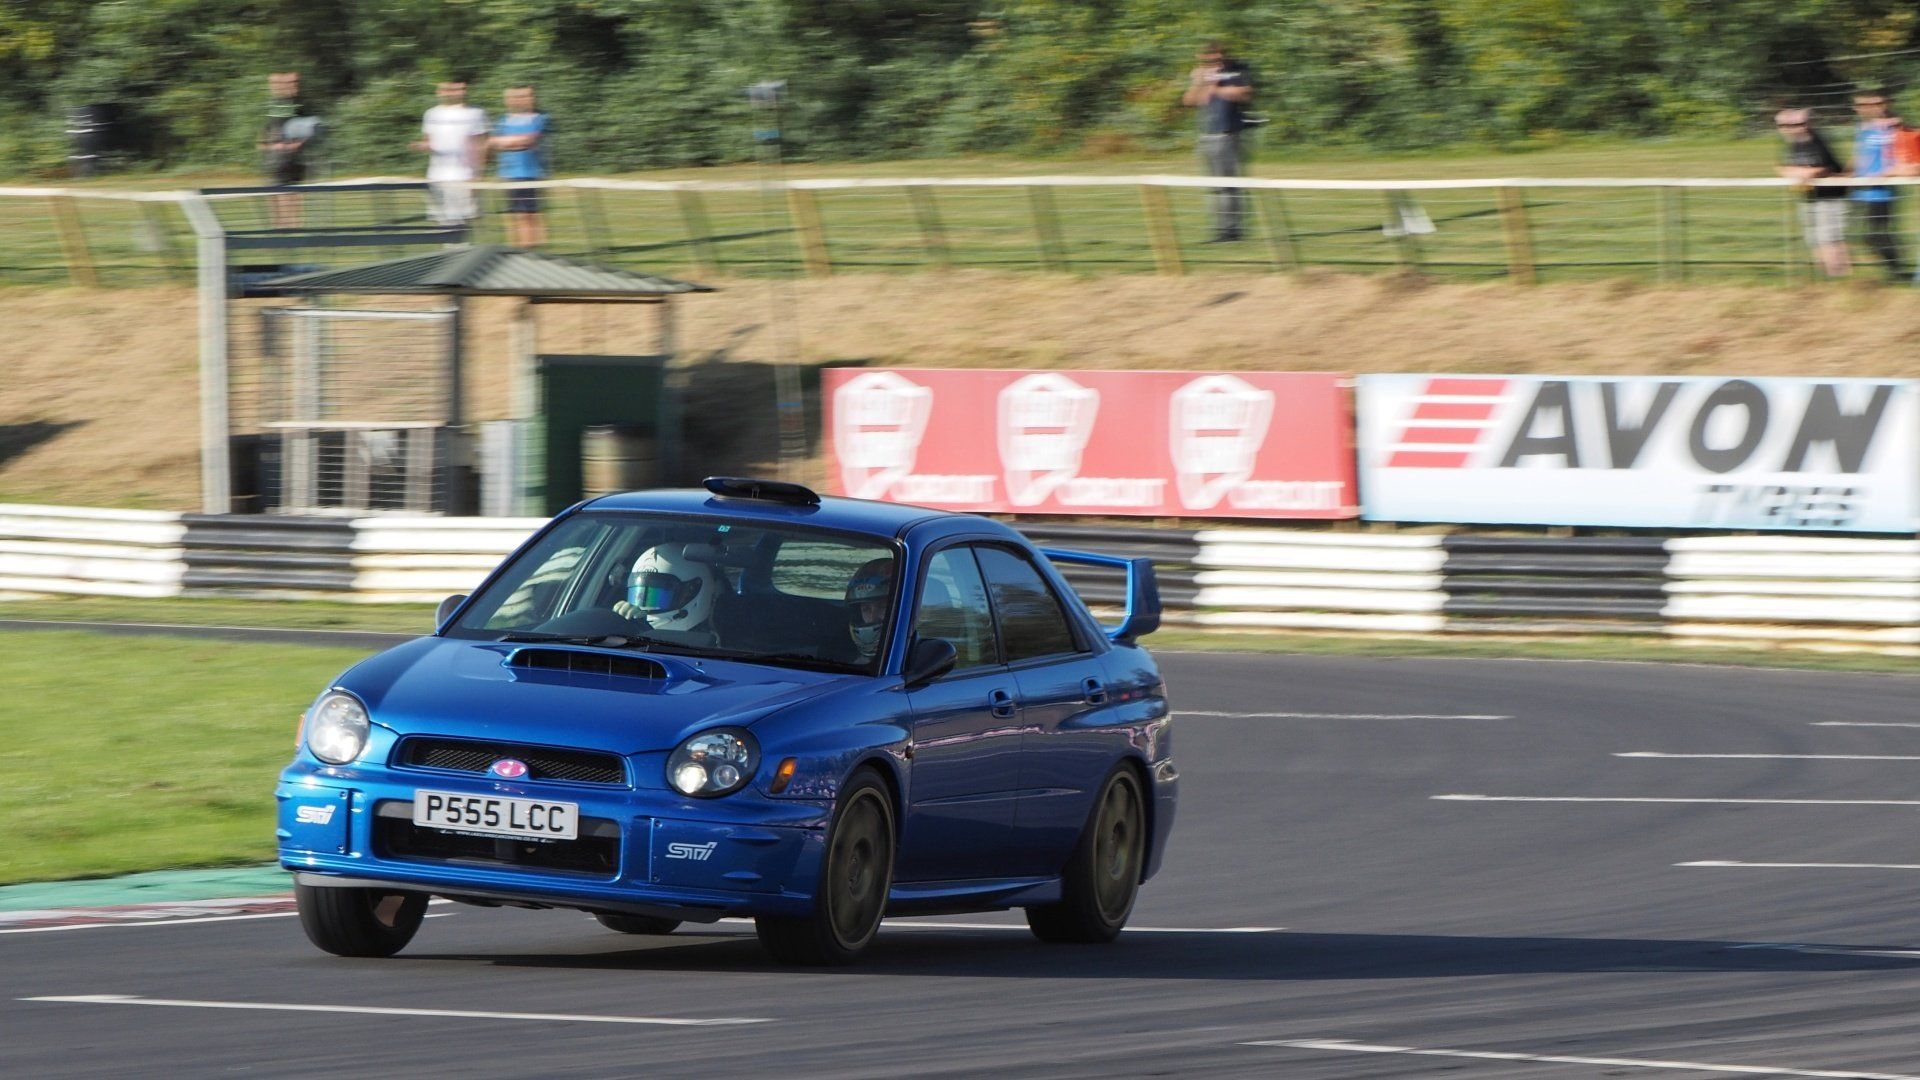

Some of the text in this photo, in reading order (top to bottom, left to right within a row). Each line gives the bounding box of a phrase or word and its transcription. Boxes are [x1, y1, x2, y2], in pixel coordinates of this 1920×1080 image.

[1499, 379, 1893, 474] AVON
[427, 794, 564, 832] P555 LCC
